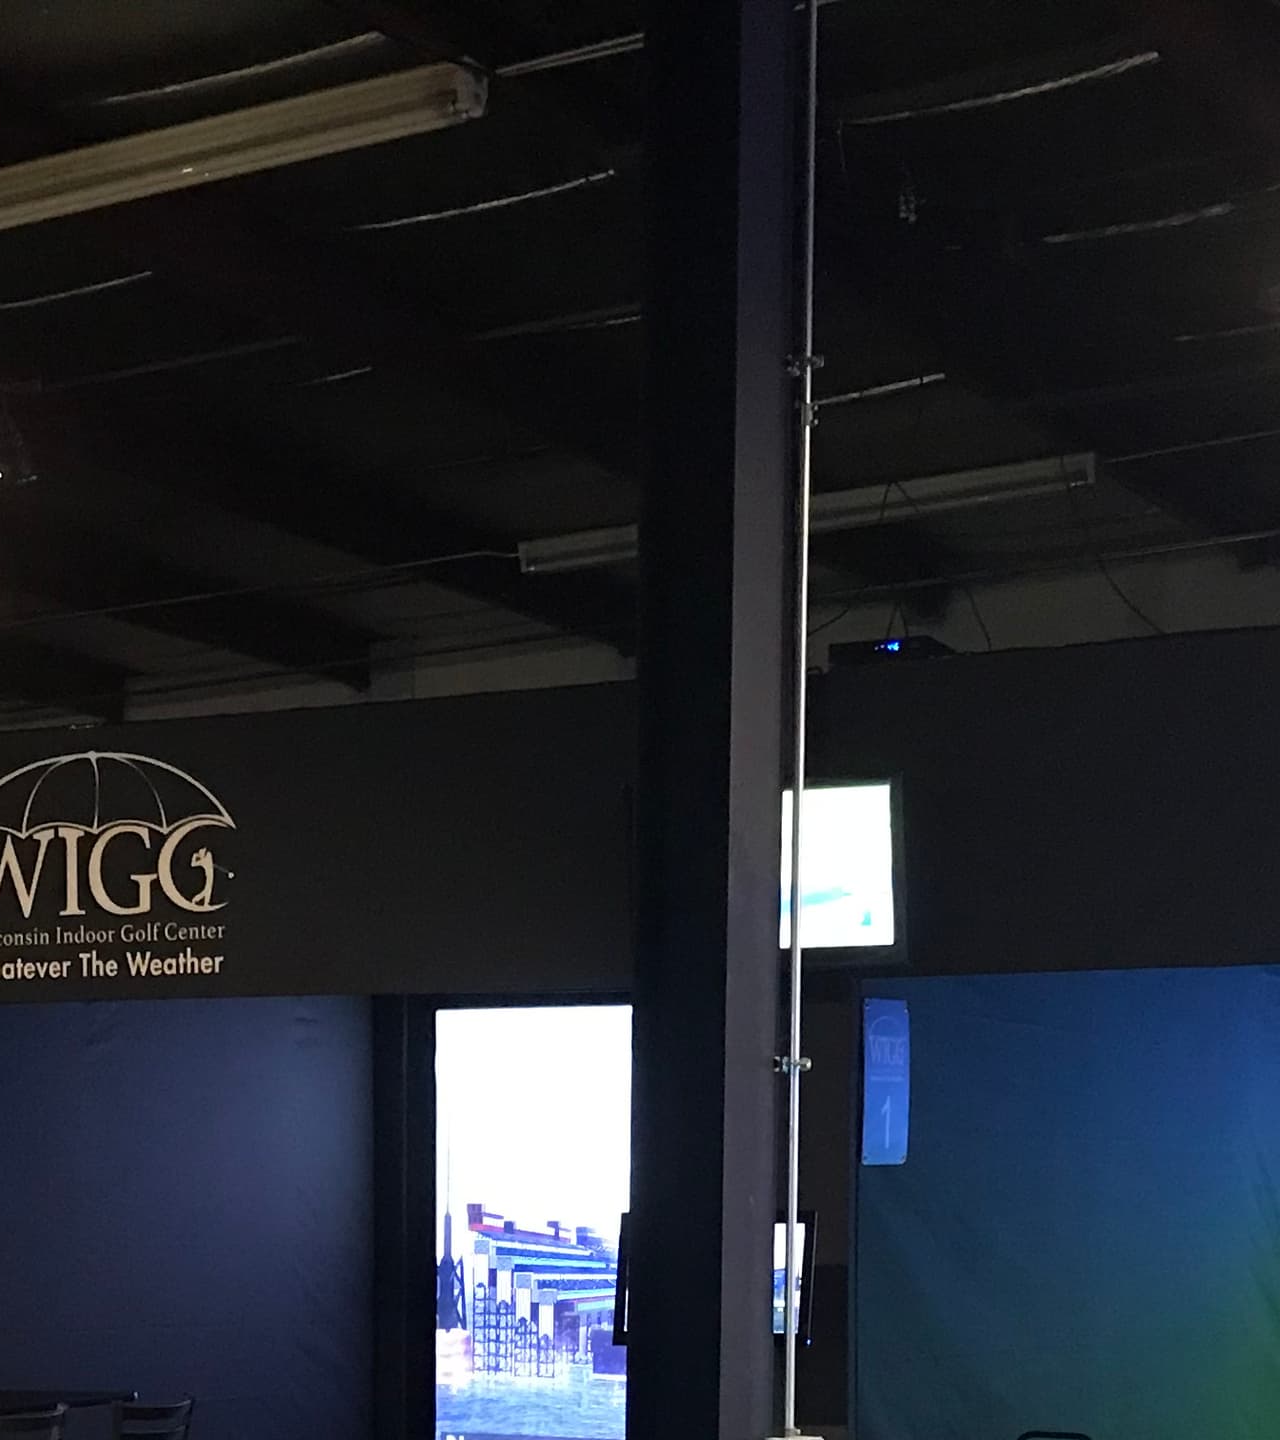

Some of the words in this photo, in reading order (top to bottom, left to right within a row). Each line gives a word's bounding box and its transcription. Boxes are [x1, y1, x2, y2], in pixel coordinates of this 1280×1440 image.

[56, 926, 116, 944] Indoor
[120, 923, 161, 942] Golf
[164, 922, 226, 941] Center
[79, 950, 119, 978] The
[126, 948, 225, 976] Weather
[881, 1096, 892, 1149] 1
